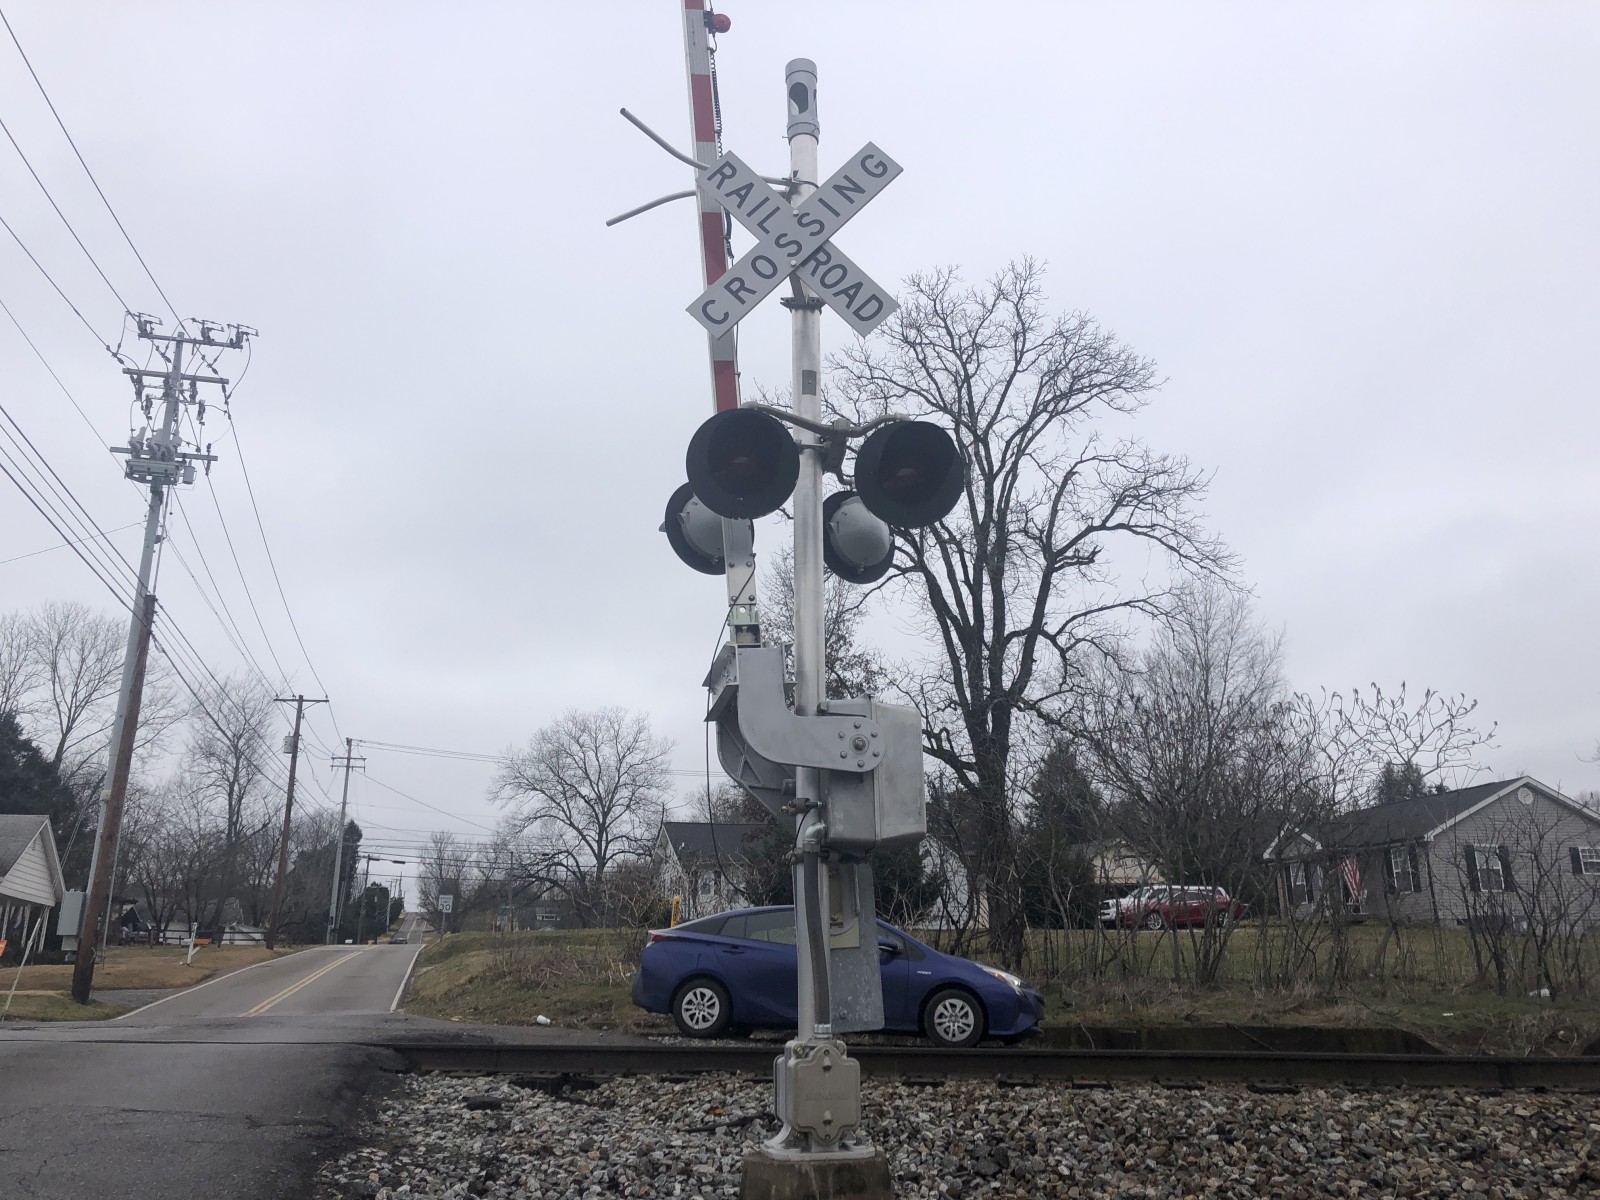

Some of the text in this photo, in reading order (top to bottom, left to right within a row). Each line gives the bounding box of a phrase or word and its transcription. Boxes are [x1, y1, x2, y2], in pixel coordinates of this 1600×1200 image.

[701, 153, 888, 325] CROSSING
[706, 160, 884, 322] RAIL ROAD
[439, 903, 451, 911] 30
